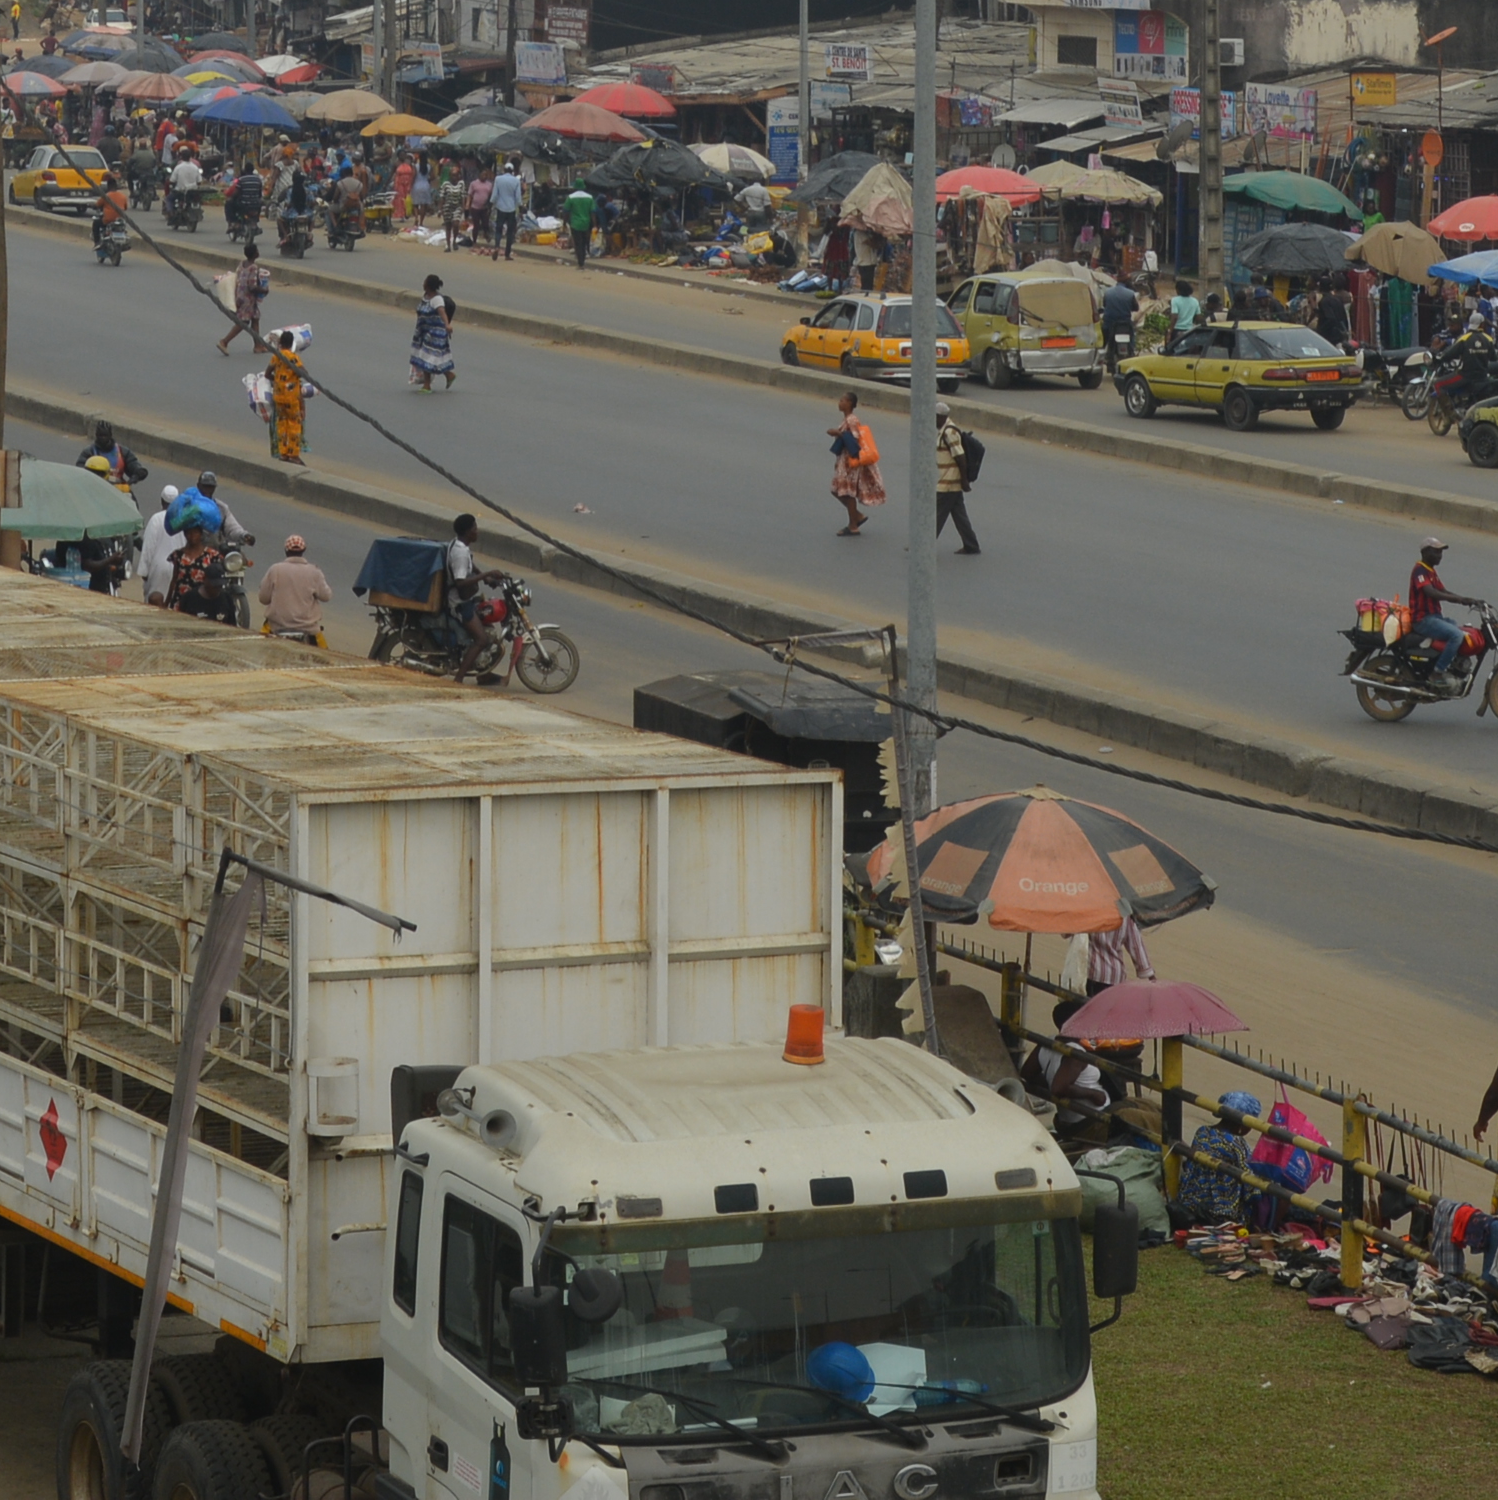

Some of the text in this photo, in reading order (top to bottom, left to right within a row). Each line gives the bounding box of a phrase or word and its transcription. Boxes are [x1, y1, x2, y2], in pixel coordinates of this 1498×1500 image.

[921, 875, 962, 894] orange
[1018, 877, 1088, 896] Orange
[1133, 878, 1168, 895] orange
